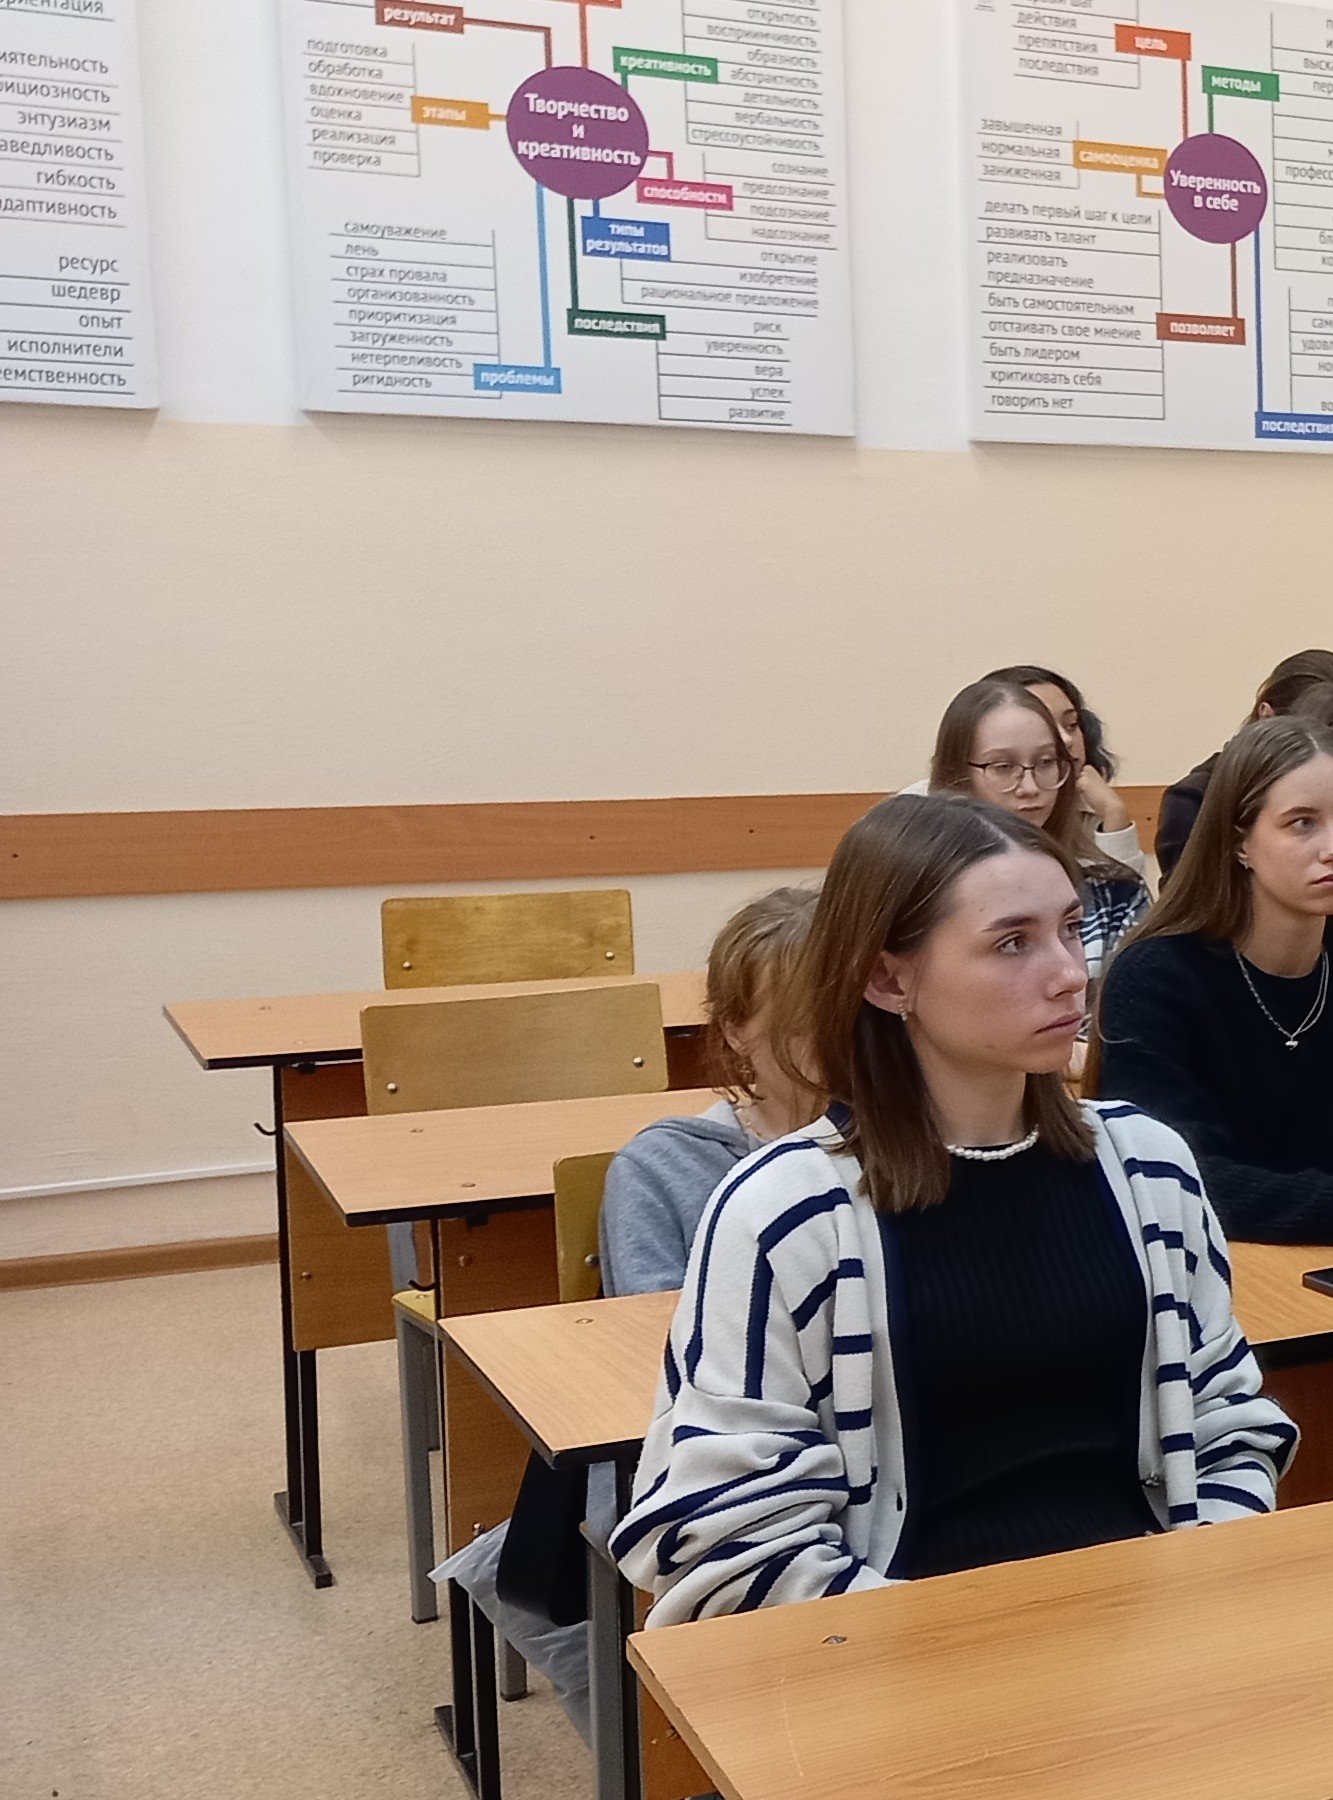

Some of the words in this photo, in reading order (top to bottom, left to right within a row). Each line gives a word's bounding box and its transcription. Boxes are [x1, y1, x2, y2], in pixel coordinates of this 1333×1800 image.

[383, 8, 457, 25] результат
[1017, 12, 1077, 28] действия
[307, 39, 388, 57] подготовка
[1018, 34, 1098, 54] препятствия
[1135, 36, 1168, 50] цель
[1326, 37, 1333, 48] и
[619, 55, 712, 76] креативность
[747, 48, 818, 68] образность
[1019, 57, 1100, 76] последствия
[308, 60, 384, 77] обработка
[730, 68, 819, 89] абстрактность
[1211, 74, 1261, 90] методы
[309, 85, 404, 103] вдохновение
[310, 106, 363, 120] оценка
[422, 106, 467, 120] этапы
[525, 91, 629, 121] Творчество
[17, 111, 111, 132] энтузиазм
[981, 119, 1063, 135] завышенная
[312, 129, 397, 145] реализация
[571, 122, 585, 139] и
[312, 150, 382, 167] проверка
[517, 139, 641, 167] креативность
[982, 142, 1060, 158] нормальная
[771, 162, 829, 177] сознание
[982, 165, 1061, 181] заниженная
[37, 170, 116, 190] гибкость
[1170, 170, 1261, 195] Уверенность
[643, 185, 728, 206] способности
[742, 182, 830, 198] предсознание
[1194, 196, 1204, 208] в
[1206, 193, 1239, 212] себе
[749, 203, 830, 220] подсознание
[985, 201, 1028, 217] делать
[1033, 204, 1081, 222] первый
[1085, 211, 1107, 223] шаг
[1111, 213, 1118, 222] к
[1122, 213, 1152, 227] цели
[344, 221, 447, 239] самоуважение
[608, 222, 645, 239] типы
[752, 227, 831, 243] надсознание
[986, 226, 1051, 244] развивать
[1056, 230, 1096, 245] талант
[345, 243, 379, 256] лень
[585, 238, 670, 258] результатов
[58, 256, 119, 274] ресурс
[760, 251, 818, 266] открытие
[987, 250, 1068, 270] реализовать
[346, 265, 385, 280] страх
[389, 266, 448, 283] провала
[738, 270, 819, 287] изобретение
[988, 270, 1094, 290] предназначение
[51, 283, 121, 304] шедевр
[347, 287, 476, 306] организованность
[640, 285, 733, 304] рациональное
[735, 294, 820, 310] предложение
[988, 292, 1018, 309] быть
[1022, 296, 1134, 316] самостоятельным
[79, 314, 123, 330] опыт
[348, 309, 457, 325] приоритизация
[574, 317, 659, 333] последствия
[752, 321, 783, 334] риск
[989, 318, 1056, 338] отстаивать
[1061, 325, 1090, 339] свое
[1095, 325, 1141, 341] мнение
[1170, 321, 1235, 337] позволяет
[7, 339, 124, 357] исполнители
[350, 331, 453, 349] загруженность
[704, 339, 784, 355] уверенность
[351, 353, 463, 370] нетерпеливость
[990, 343, 1019, 359] быть
[1024, 347, 1080, 363] лидером
[0, 368, 127, 386] емственность
[480, 370, 555, 387] проблемы
[754, 364, 784, 377] вера
[991, 369, 1070, 386] критиковать
[1074, 373, 1101, 387] себя
[352, 373, 433, 389] ригидность
[750, 386, 786, 400] успех
[992, 394, 1049, 412] говорить
[1052, 396, 1073, 409] нет
[728, 406, 786, 422] развитие
